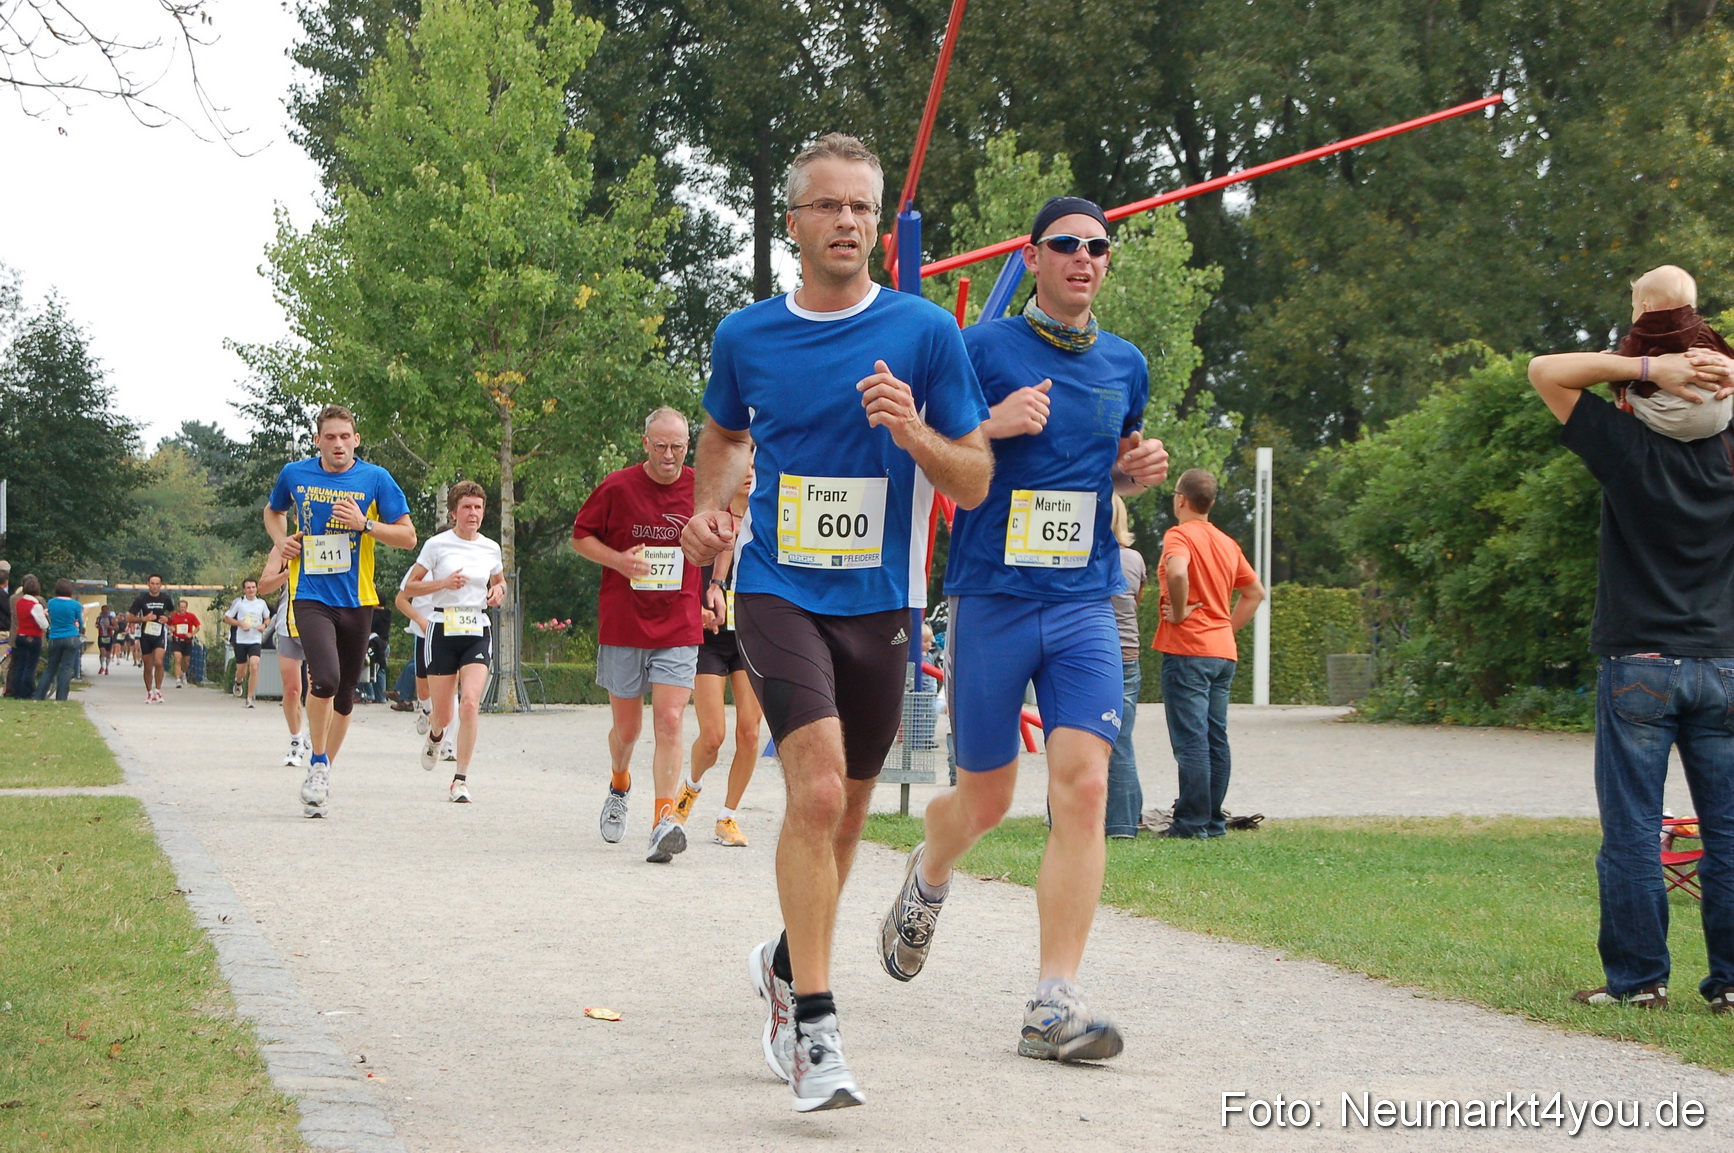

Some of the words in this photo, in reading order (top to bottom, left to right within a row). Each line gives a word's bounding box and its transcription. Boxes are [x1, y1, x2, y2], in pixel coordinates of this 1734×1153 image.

[296, 485, 306, 493] 10.
[307, 485, 366, 501] NEUMARKTER
[808, 484, 848, 502] Franz
[1035, 496, 1071, 512] Martin
[783, 508, 790, 522] C
[817, 513, 869, 538] 600
[1012, 517, 1019, 529] C
[632, 524, 678, 541] JAKO
[1042, 521, 1081, 542] 652
[315, 539, 326, 547] Jan
[320, 549, 342, 561] 411
[644, 550, 676, 559] Reinhard
[843, 552, 880, 563] PFLEIDERER
[650, 563, 675, 576] 577
[459, 615, 478, 625] 354
